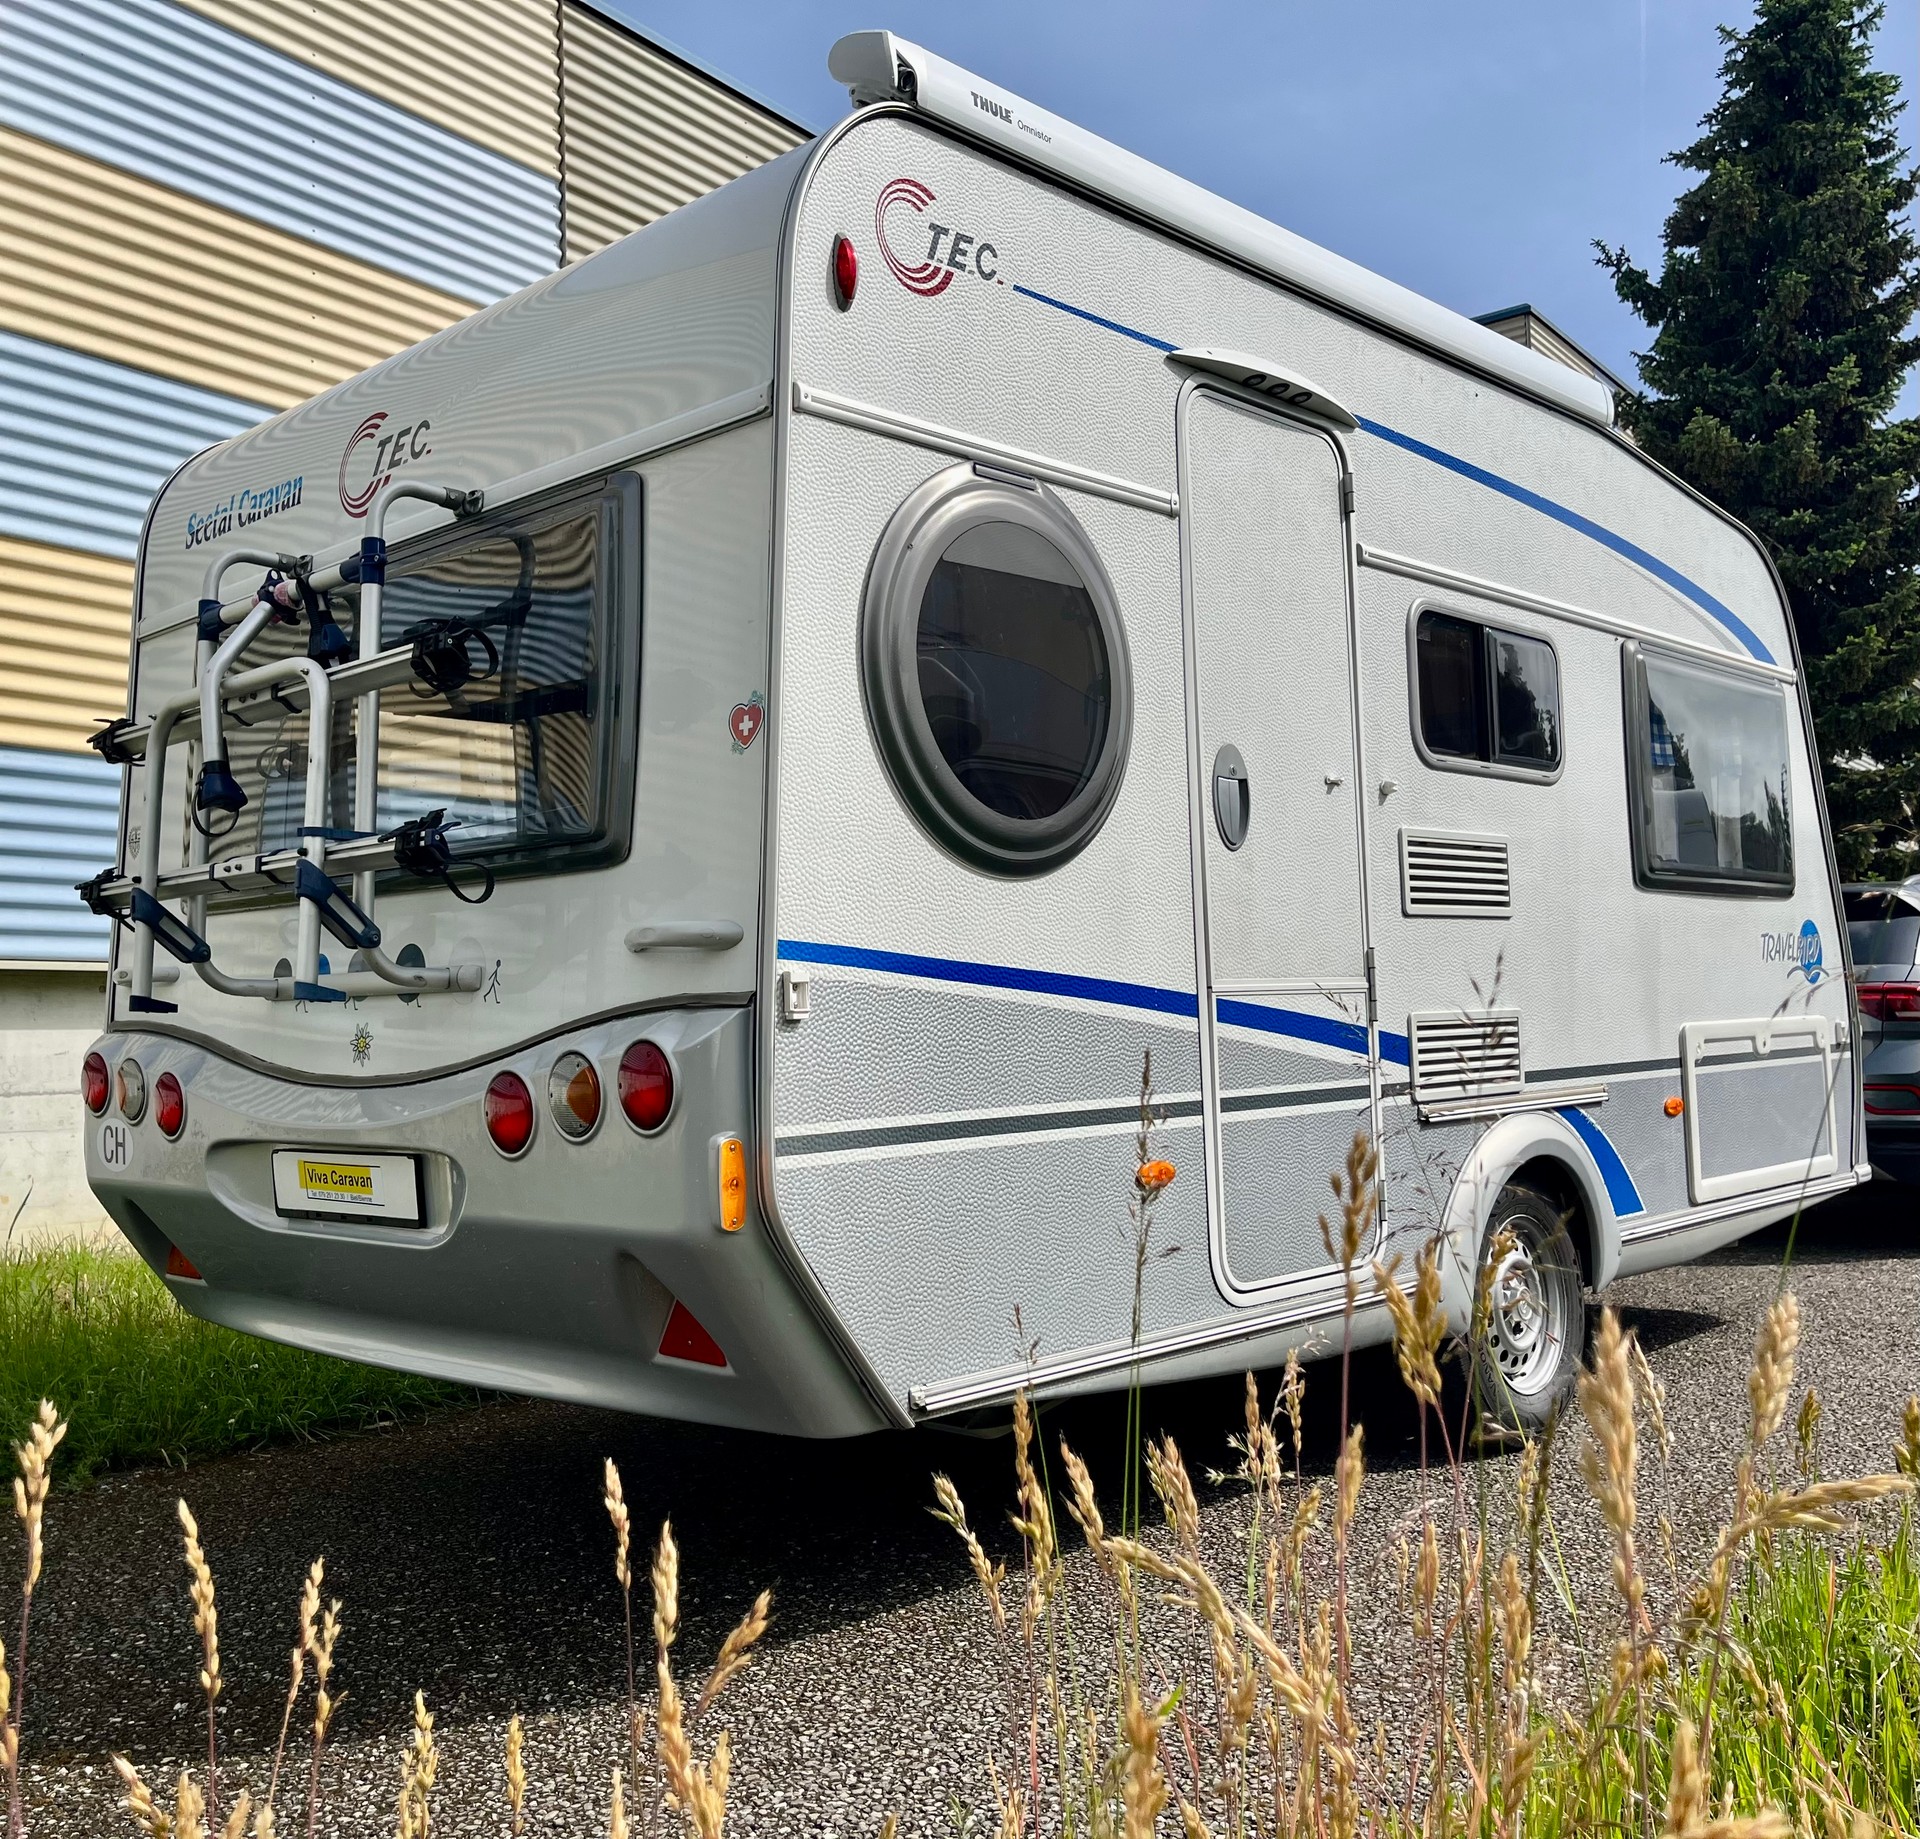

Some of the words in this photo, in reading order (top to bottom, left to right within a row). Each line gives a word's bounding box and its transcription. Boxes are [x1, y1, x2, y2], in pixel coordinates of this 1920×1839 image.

[970, 90, 1013, 125] THULE
[1017, 119, 1052, 144] Omnistor
[185, 494, 235, 550] Seetal
[237, 475, 304, 529] Caravan
[103, 1125, 126, 1166] CH
[306, 1167, 329, 1185] Viva
[330, 1169, 373, 1189] Caravan
